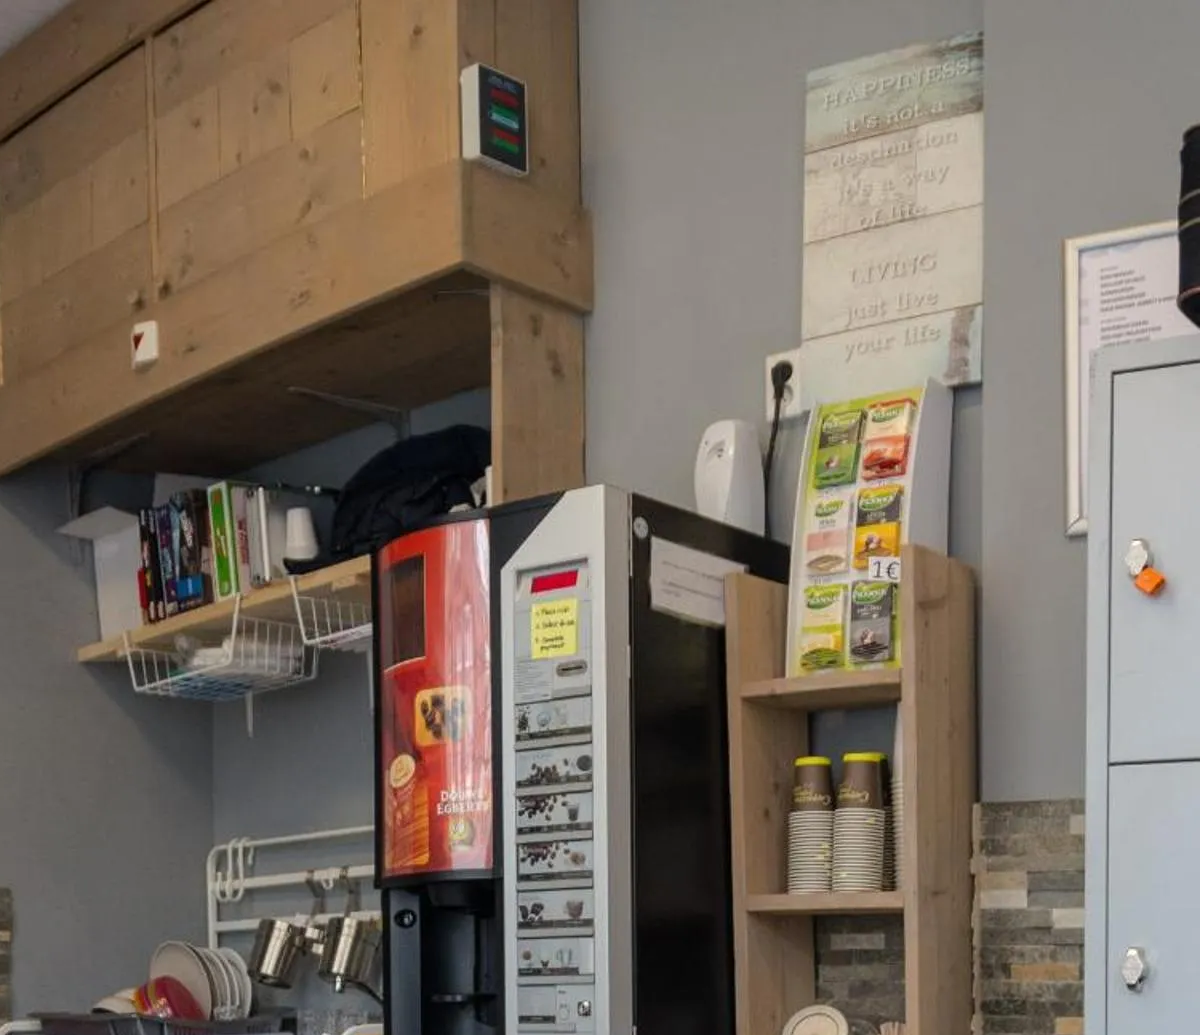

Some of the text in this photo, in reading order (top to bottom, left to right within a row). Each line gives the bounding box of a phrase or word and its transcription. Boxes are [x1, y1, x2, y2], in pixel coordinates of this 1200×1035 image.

[824, 57, 971, 110] HAPPINESS
[887, 104, 922, 123] not
[902, 165, 950, 187] way
[852, 252, 938, 285] LIVING
[845, 292, 939, 328] just live
[845, 325, 941, 363] your life
[872, 560, 900, 580] 1€
